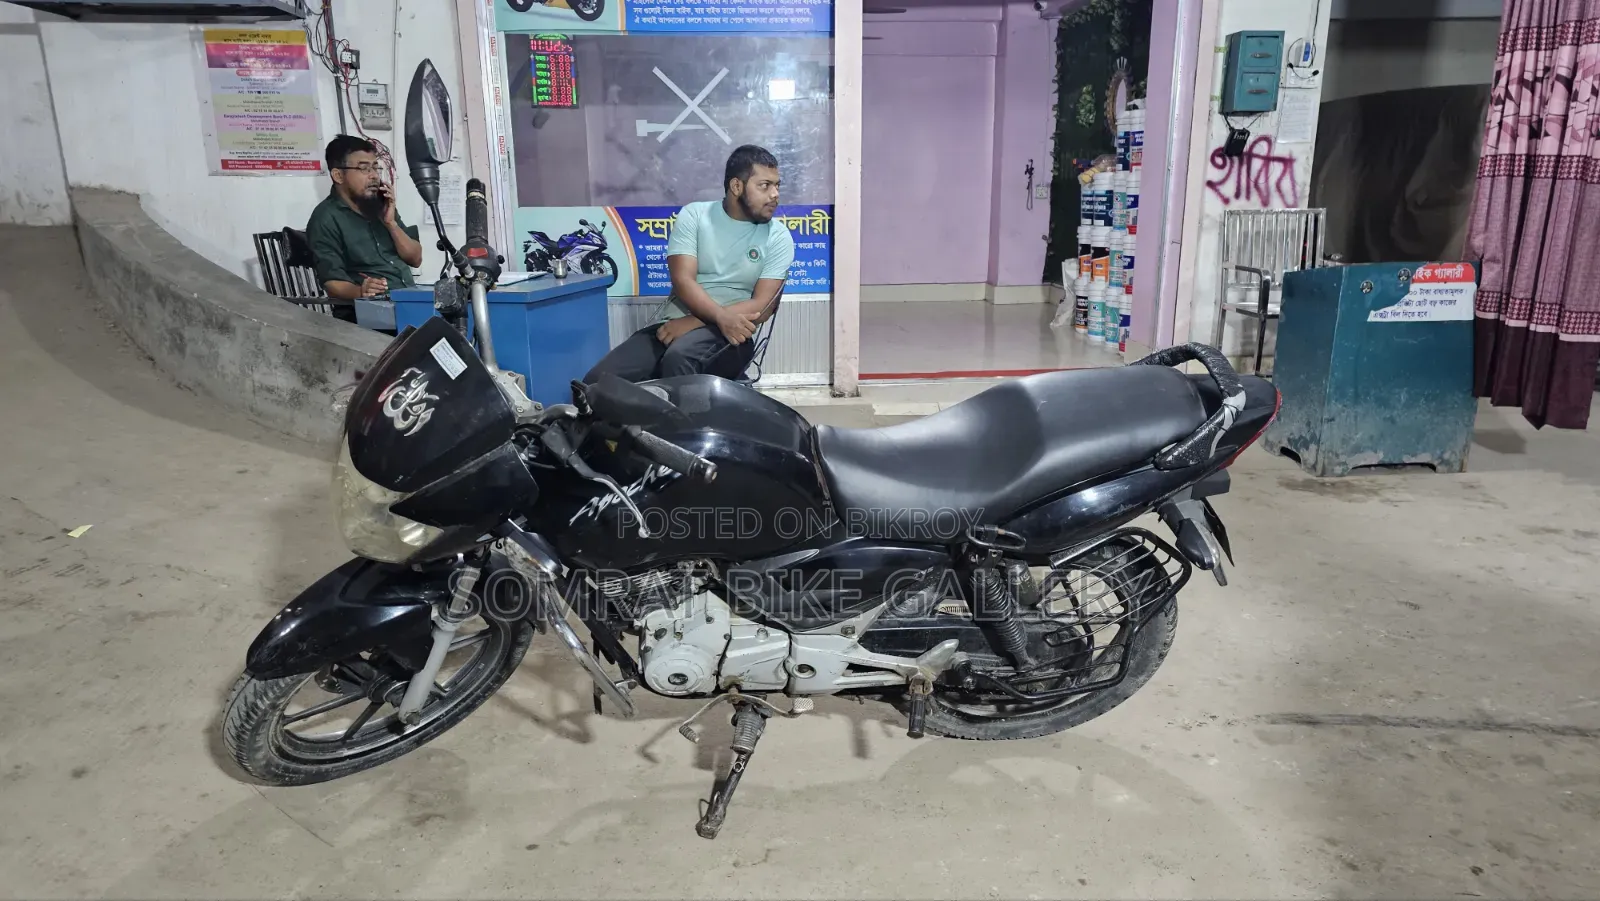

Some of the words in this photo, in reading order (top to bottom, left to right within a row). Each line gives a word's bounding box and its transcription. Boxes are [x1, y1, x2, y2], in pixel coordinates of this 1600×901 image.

[635, 212, 678, 240] সম্রা
[772, 209, 832, 236] ালারী
[1434, 264, 1464, 279] গ্যালারী
